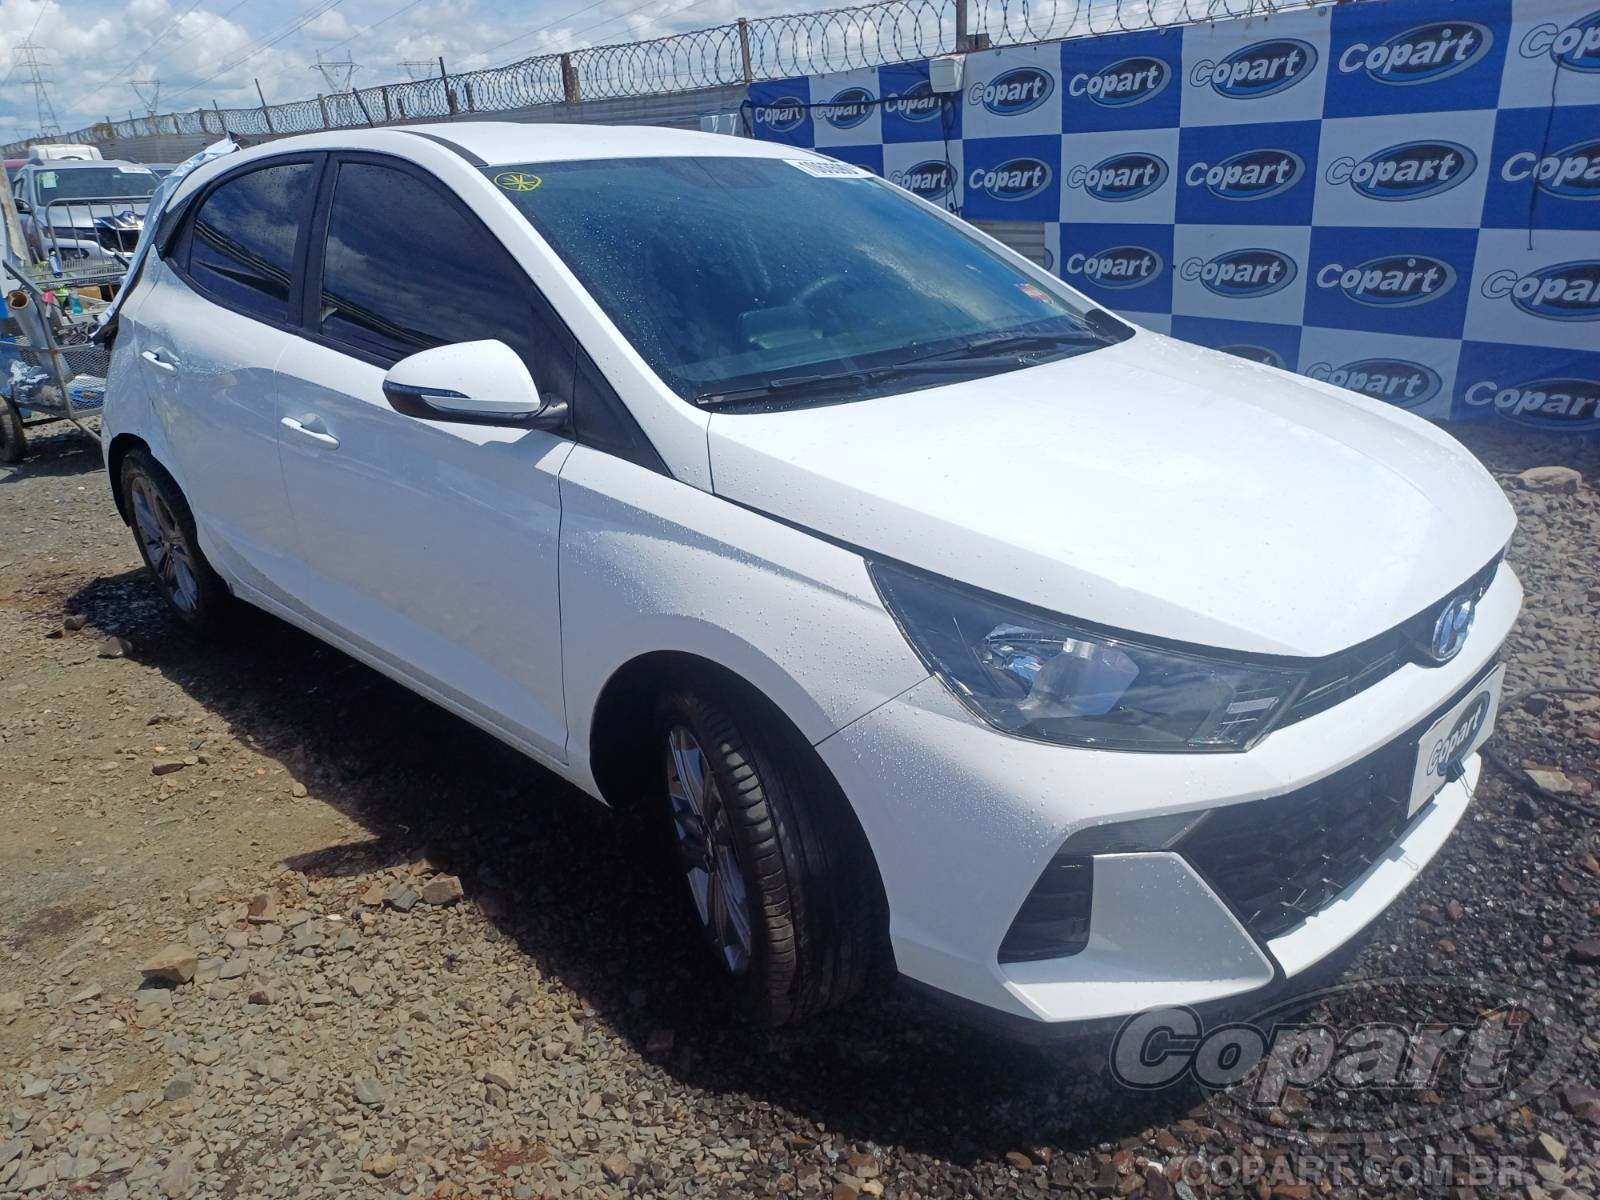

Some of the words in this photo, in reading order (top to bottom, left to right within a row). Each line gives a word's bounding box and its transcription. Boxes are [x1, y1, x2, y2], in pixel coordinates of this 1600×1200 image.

[1338, 30, 1474, 75] Copart
[1069, 61, 1159, 98] Copart
[1190, 49, 1300, 89] Copart
[968, 75, 1042, 106] Copart
[755, 107, 800, 125] Copart
[889, 169, 946, 192] Copart
[969, 165, 1043, 192] Copart
[1067, 162, 1155, 192] Copart
[1185, 159, 1290, 191] Copart
[1325, 152, 1456, 189] Copart
[1066, 253, 1154, 279] Copart
[1180, 256, 1281, 287] Copart
[1316, 263, 1439, 295] Copart
[1481, 269, 1600, 306] Copa
[1305, 361, 1422, 398] Copart
[1427, 703, 1483, 776] Copart
